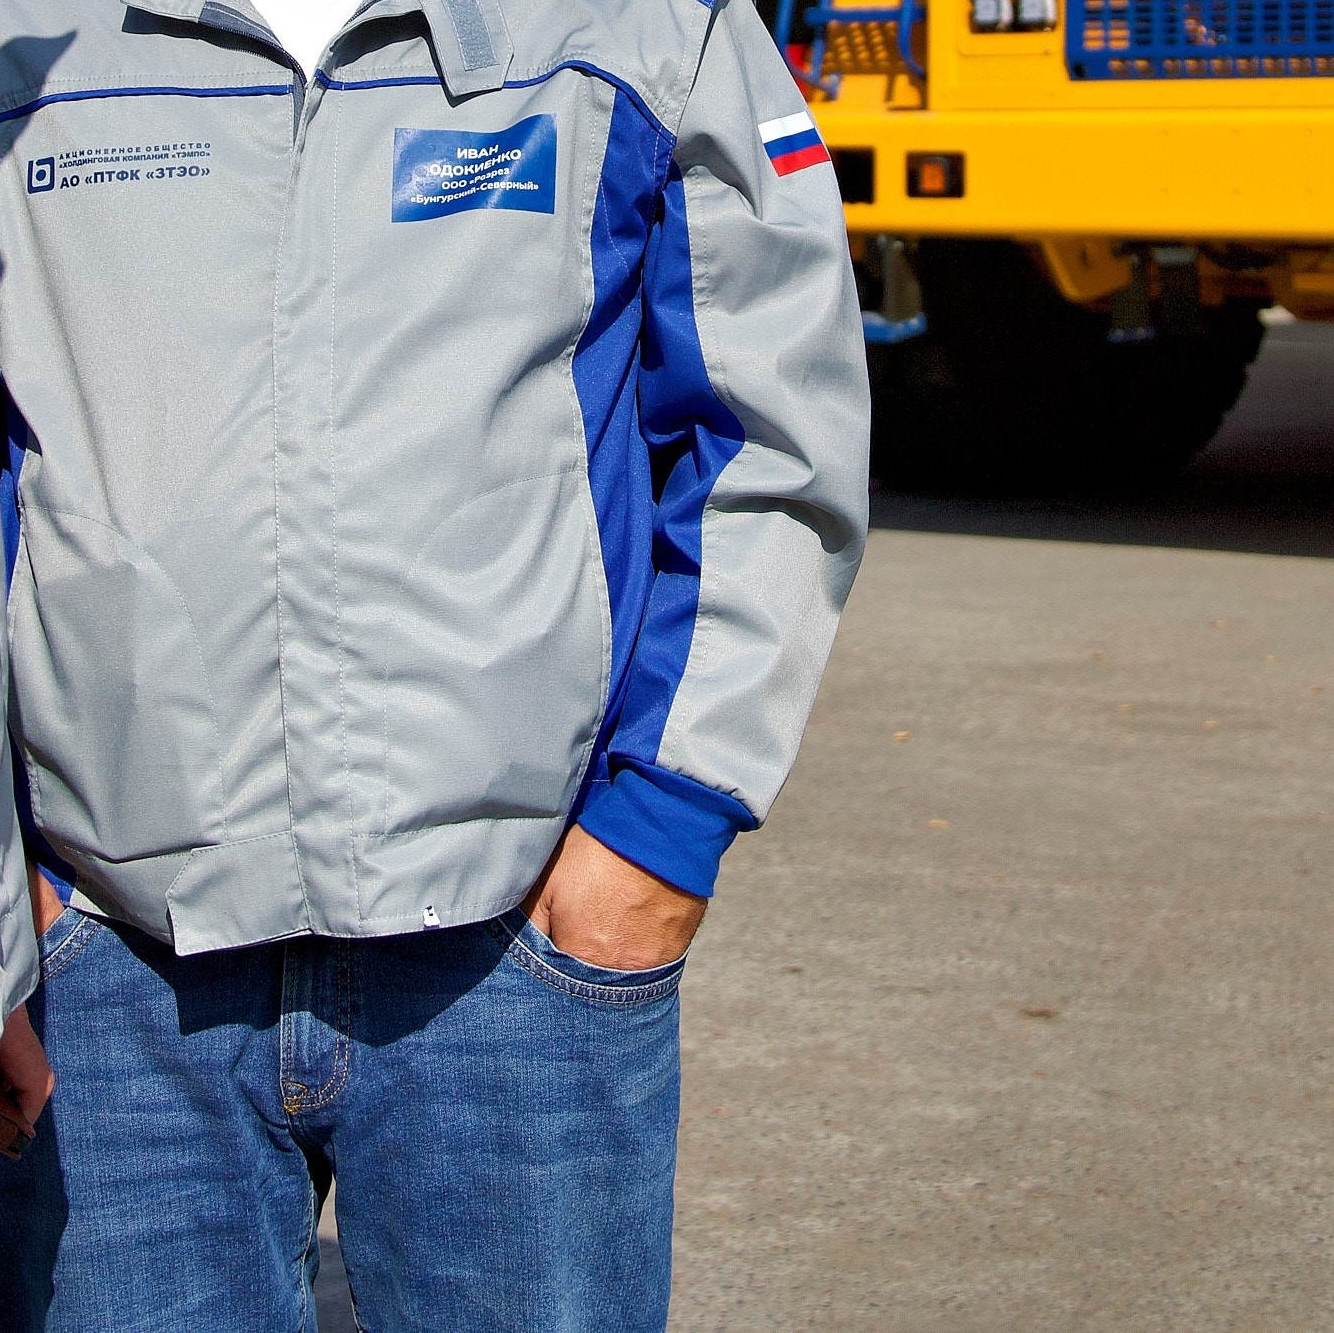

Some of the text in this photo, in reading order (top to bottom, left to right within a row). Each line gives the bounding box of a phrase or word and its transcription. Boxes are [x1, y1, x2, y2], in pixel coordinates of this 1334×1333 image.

[59, 143, 211, 160] АКЦИОНЕРНОЕ ОБЩЕСТВО
[122, 153, 169, 162] КОМПАНИЯ
[457, 144, 499, 159] ИВАН
[430, 149, 522, 178] ОДОКИЕНКО
[60, 166, 211, 189] АО «ПТФК «ЗТЭО»
